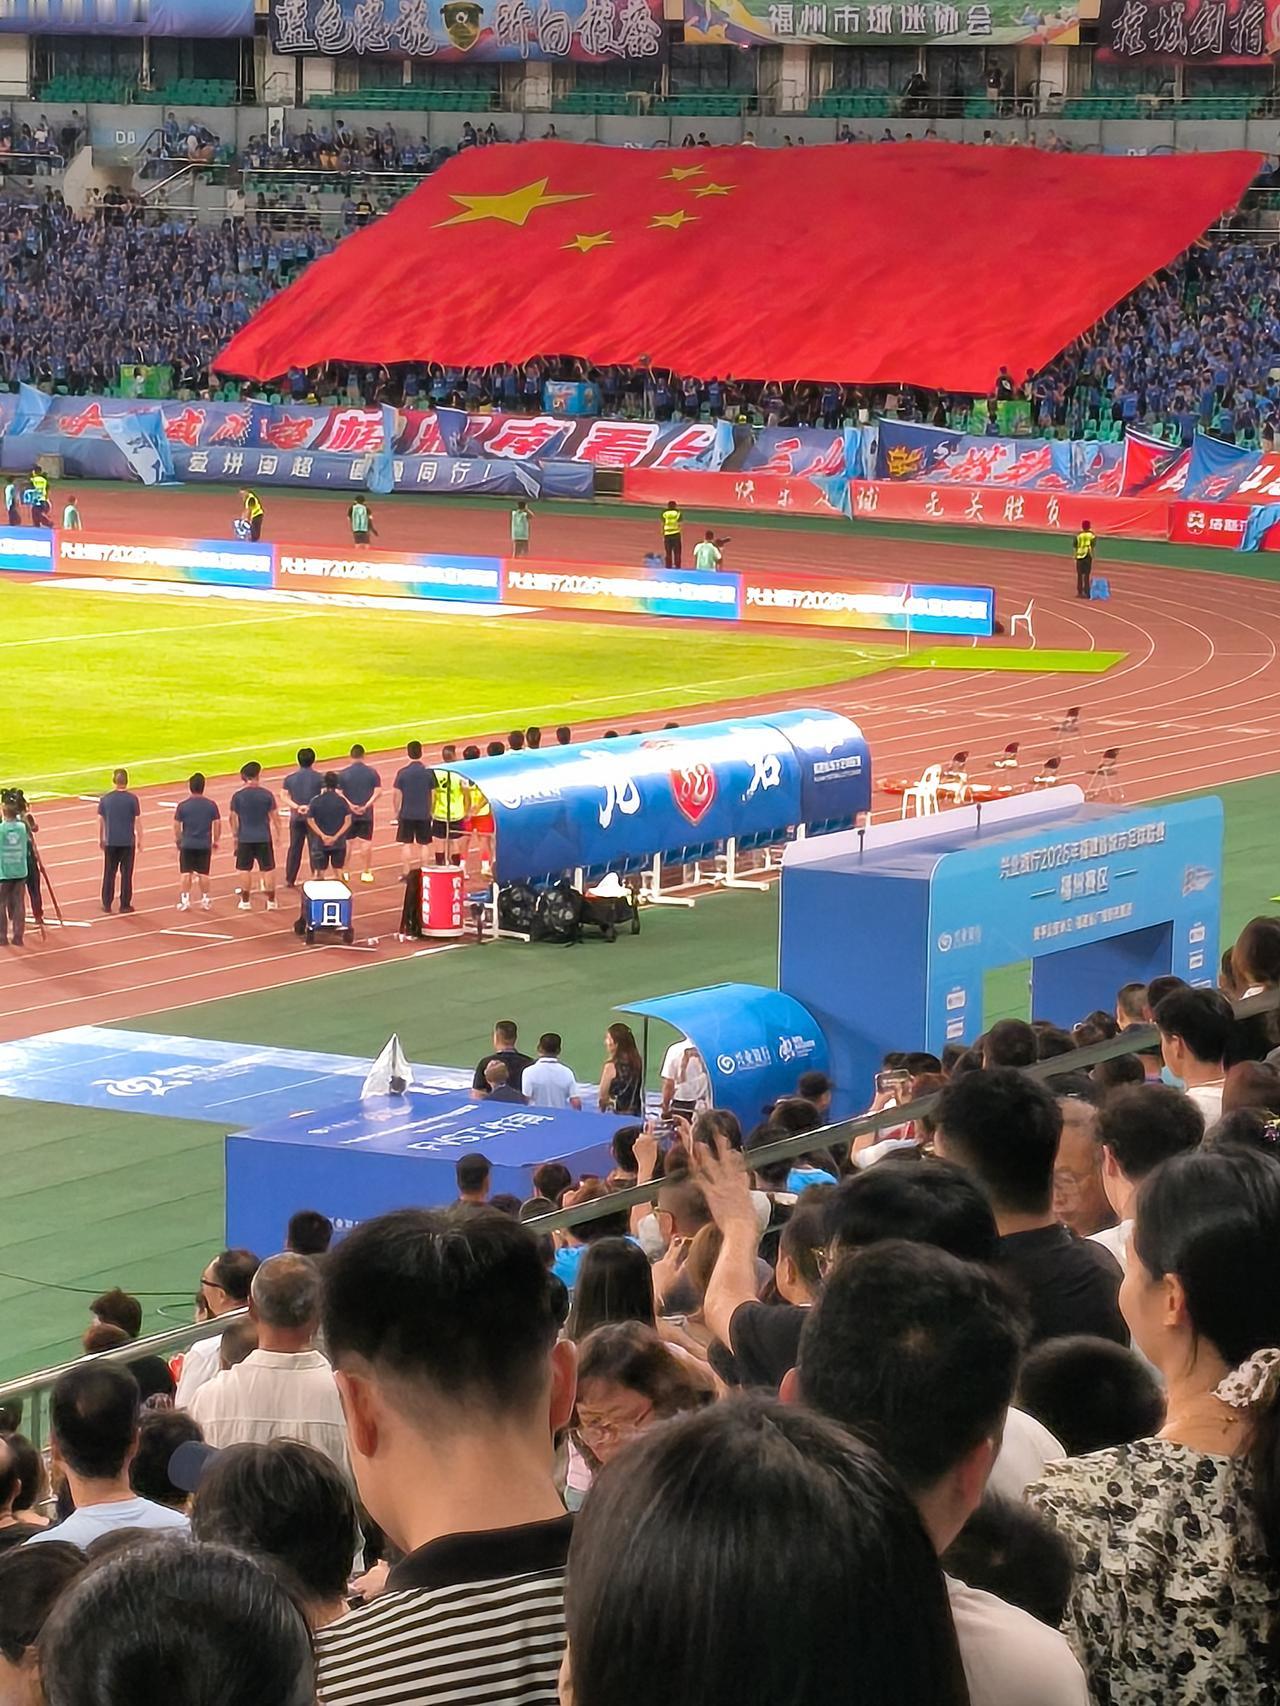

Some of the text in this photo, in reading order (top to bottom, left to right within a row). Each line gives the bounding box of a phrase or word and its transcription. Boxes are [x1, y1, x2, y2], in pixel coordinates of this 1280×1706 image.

[768, 3, 993, 36] 福州市球迷协会
[924, 490, 1062, 529] 无关胜负
